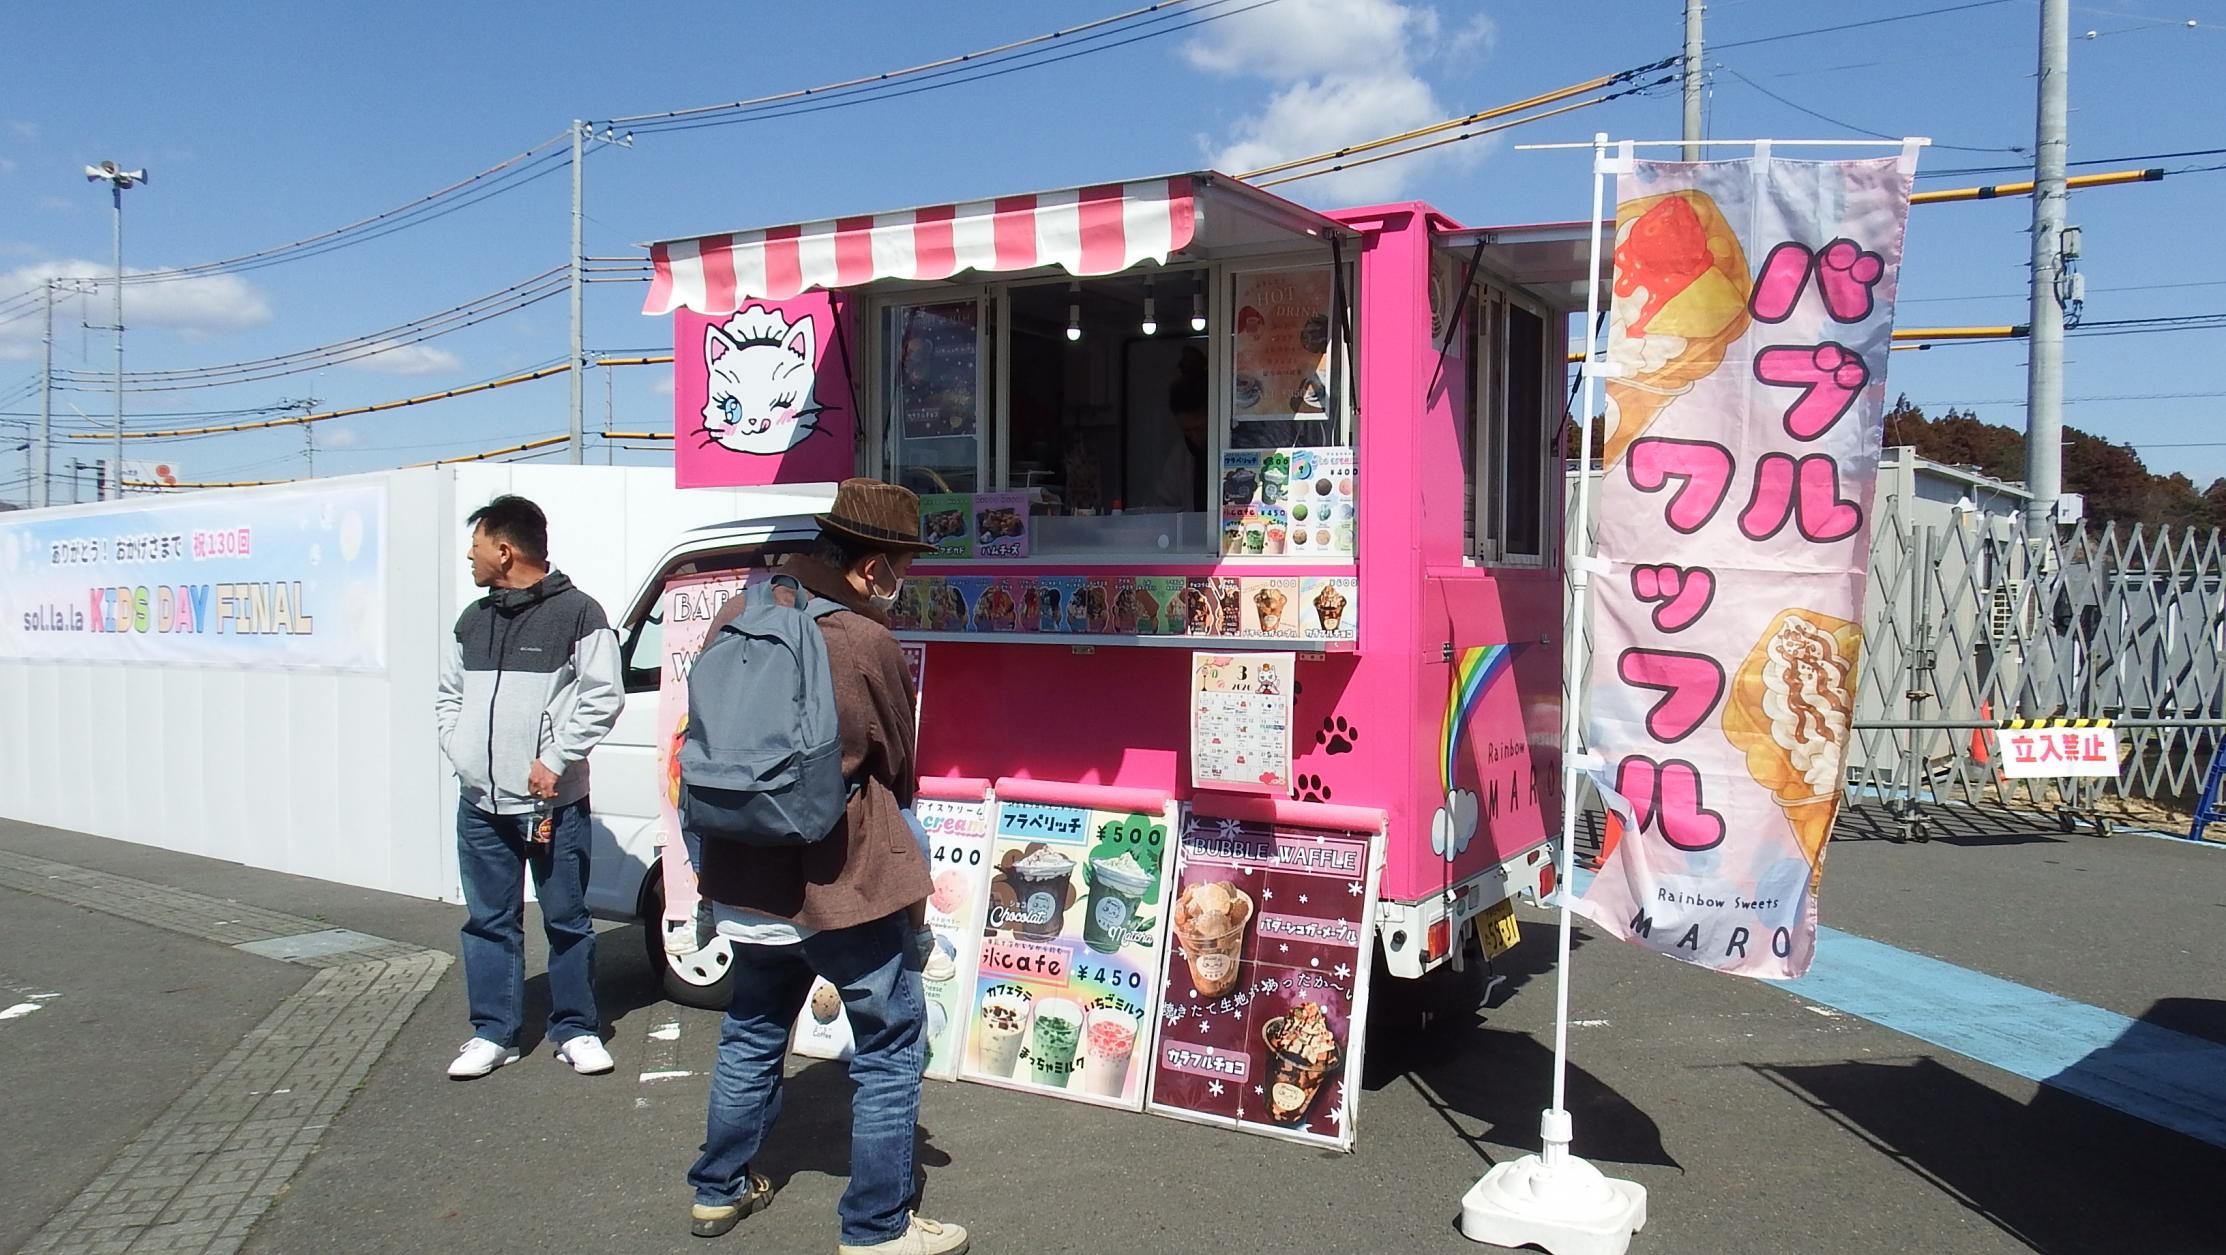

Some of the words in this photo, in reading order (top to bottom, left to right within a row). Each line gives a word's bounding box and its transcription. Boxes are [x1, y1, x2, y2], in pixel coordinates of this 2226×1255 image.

[1738, 237, 1886, 543] バブル
[192, 528, 251, 557] 祝130回
[23, 602, 84, 632] sol.la.la
[90, 586, 150, 634] KIDS
[158, 584, 209, 634] DAY
[216, 581, 313, 635] FINAL
[1616, 436, 1737, 852] ワッフル
[1236, 665, 1248, 681] 3
[1488, 740, 1525, 765] Rainbow
[2011, 734, 2107, 763] 立入禁止
[1488, 760, 1556, 821] MARO
[1004, 814, 1082, 833] フラペリッチ
[1096, 824, 1161, 847] ¥500
[1193, 838, 1270, 862] BUBBLE
[1278, 845, 1358, 870] WAFFLE
[1656, 887, 1726, 909] Rainbow
[1733, 896, 1780, 911] Sweets
[989, 906, 1044, 927] Chocolat
[1108, 925, 1154, 948] Matcha
[1629, 907, 1793, 960] MARO
[1077, 965, 1142, 989] ¥450
[986, 984, 1034, 1002] カフェラテ
[1084, 994, 1146, 1020] いちごミルク
[1019, 1046, 1086, 1075] まっちゃミルク
[1167, 1049, 1246, 1076] カラフルチョコ
